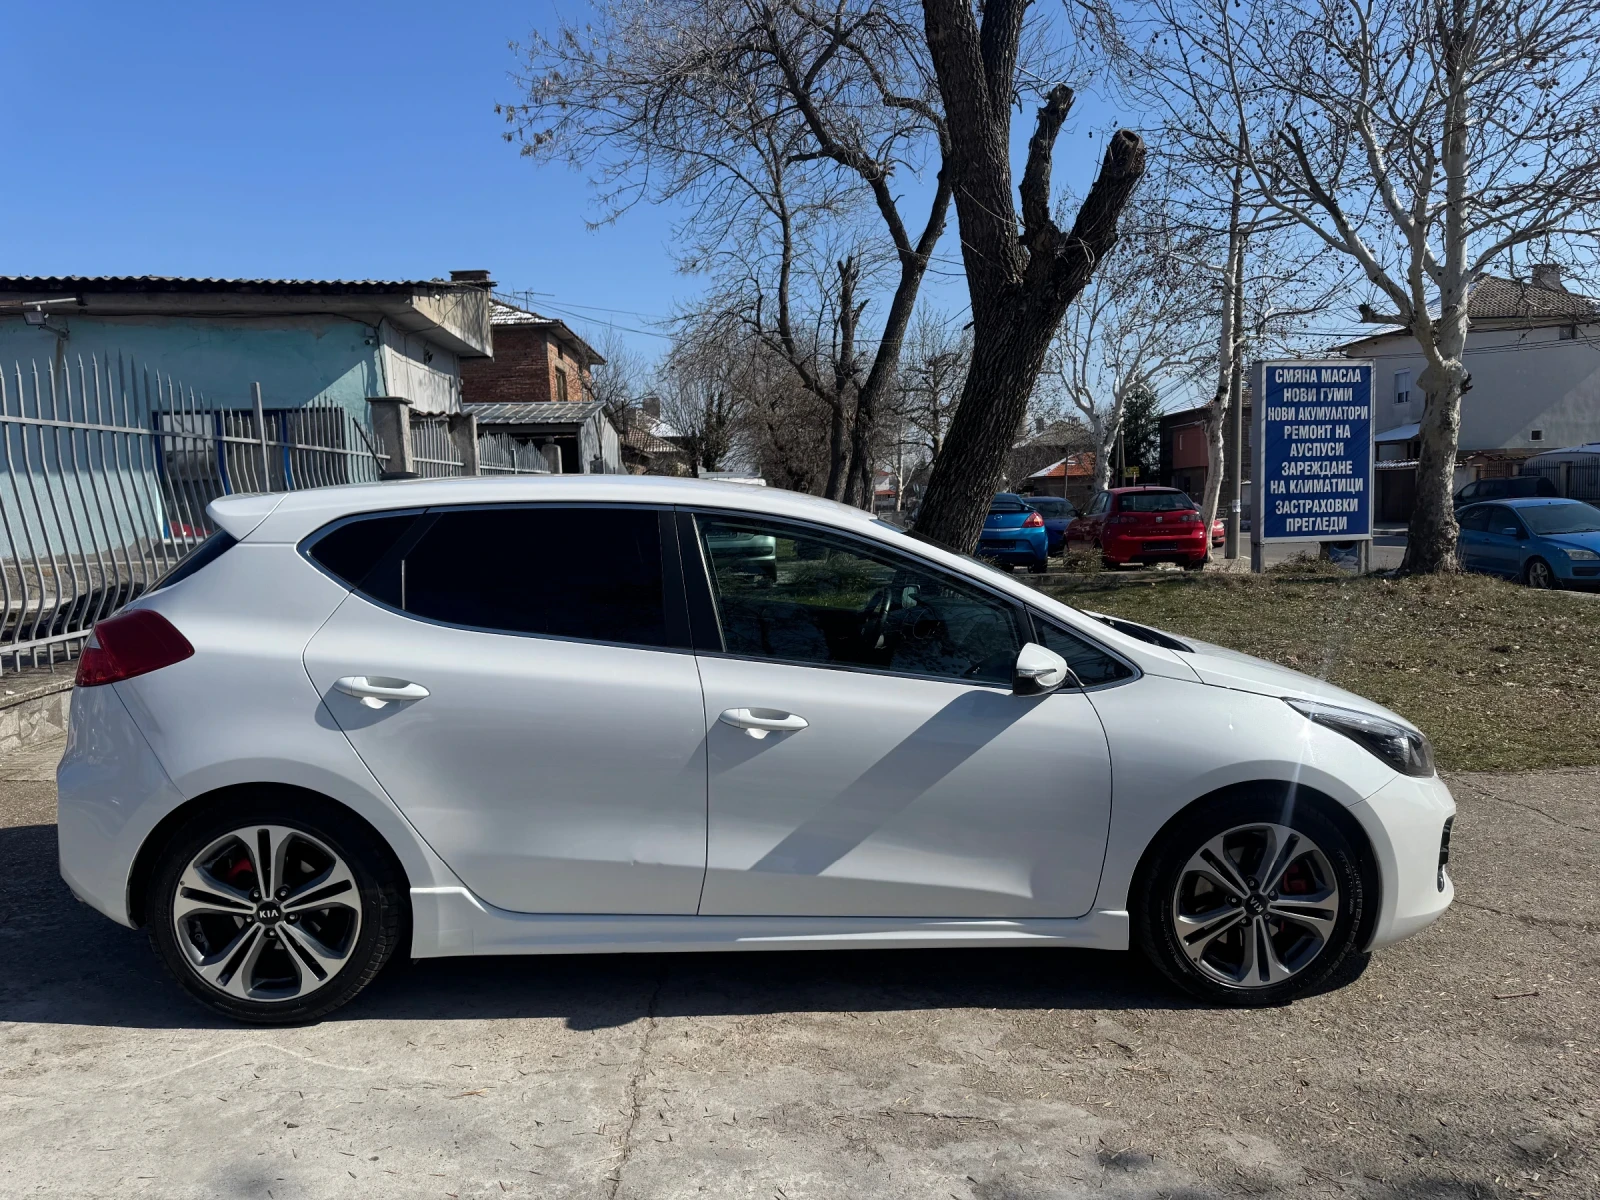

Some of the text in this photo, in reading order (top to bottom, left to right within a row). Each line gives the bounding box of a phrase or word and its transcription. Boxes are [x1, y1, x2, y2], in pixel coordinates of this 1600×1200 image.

[1275, 369, 1361, 383] СМЯНА МАСЛА
[1284, 388, 1352, 402] НОВИ ГУМИ
[1268, 406, 1368, 420] НОВИ АКУМУЛАТОРИ
[1284, 425, 1351, 439] РЕМОНТ НА
[1290, 442, 1344, 456] АУСПУСИ
[1282, 461, 1352, 477] ЗАРЕЖДАНЕ
[1270, 478, 1364, 494] НА КЛИМАТИЦИ
[1276, 499, 1358, 514] ЗАСТРАХОВКИ
[1286, 516, 1348, 532] ПРЕГЛЕДИ
[1250, 896, 1264, 913] KIA
[259, 909, 279, 918] KIA
